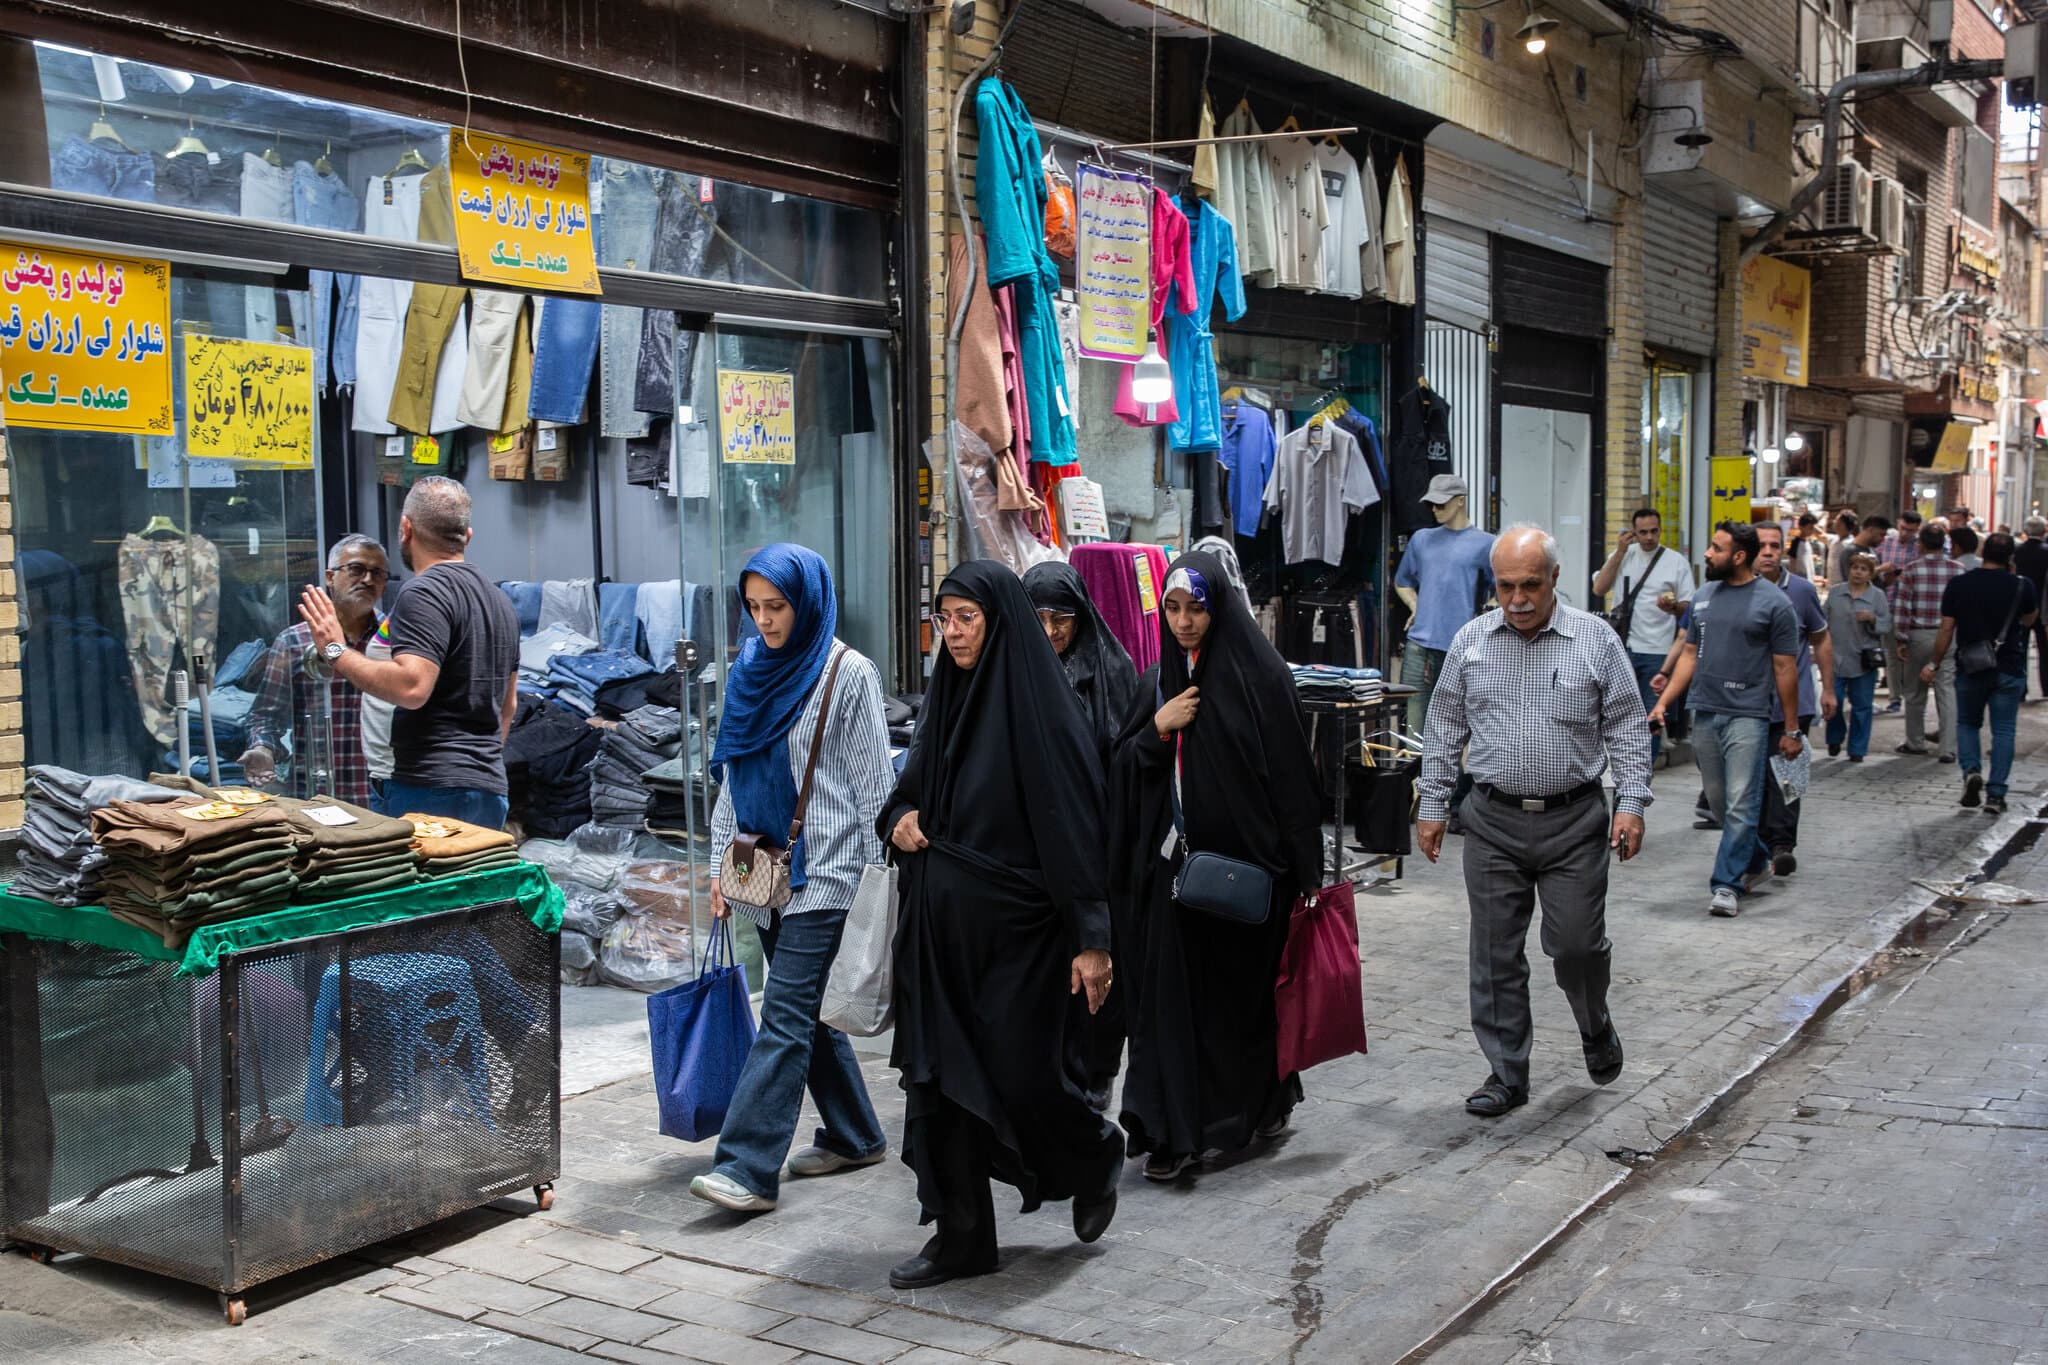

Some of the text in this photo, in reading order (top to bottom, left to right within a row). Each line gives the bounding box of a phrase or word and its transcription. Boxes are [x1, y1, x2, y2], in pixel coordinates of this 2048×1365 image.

[480, 145, 560, 189] تولید و پخش
[459, 188, 586, 235] شلوار لی ارزان قیمت
[4, 254, 123, 305] تولید و پخش
[537, 253, 568, 273] عمده
[28, 312, 81, 354] ارزان
[86, 318, 112, 357] لی
[117, 322, 164, 361] شلوار
[81, 385, 128, 410] عمده
[194, 383, 236, 425] تومان
[728, 426, 752, 453] تومان
[1715, 480, 1748, 501] خرید
